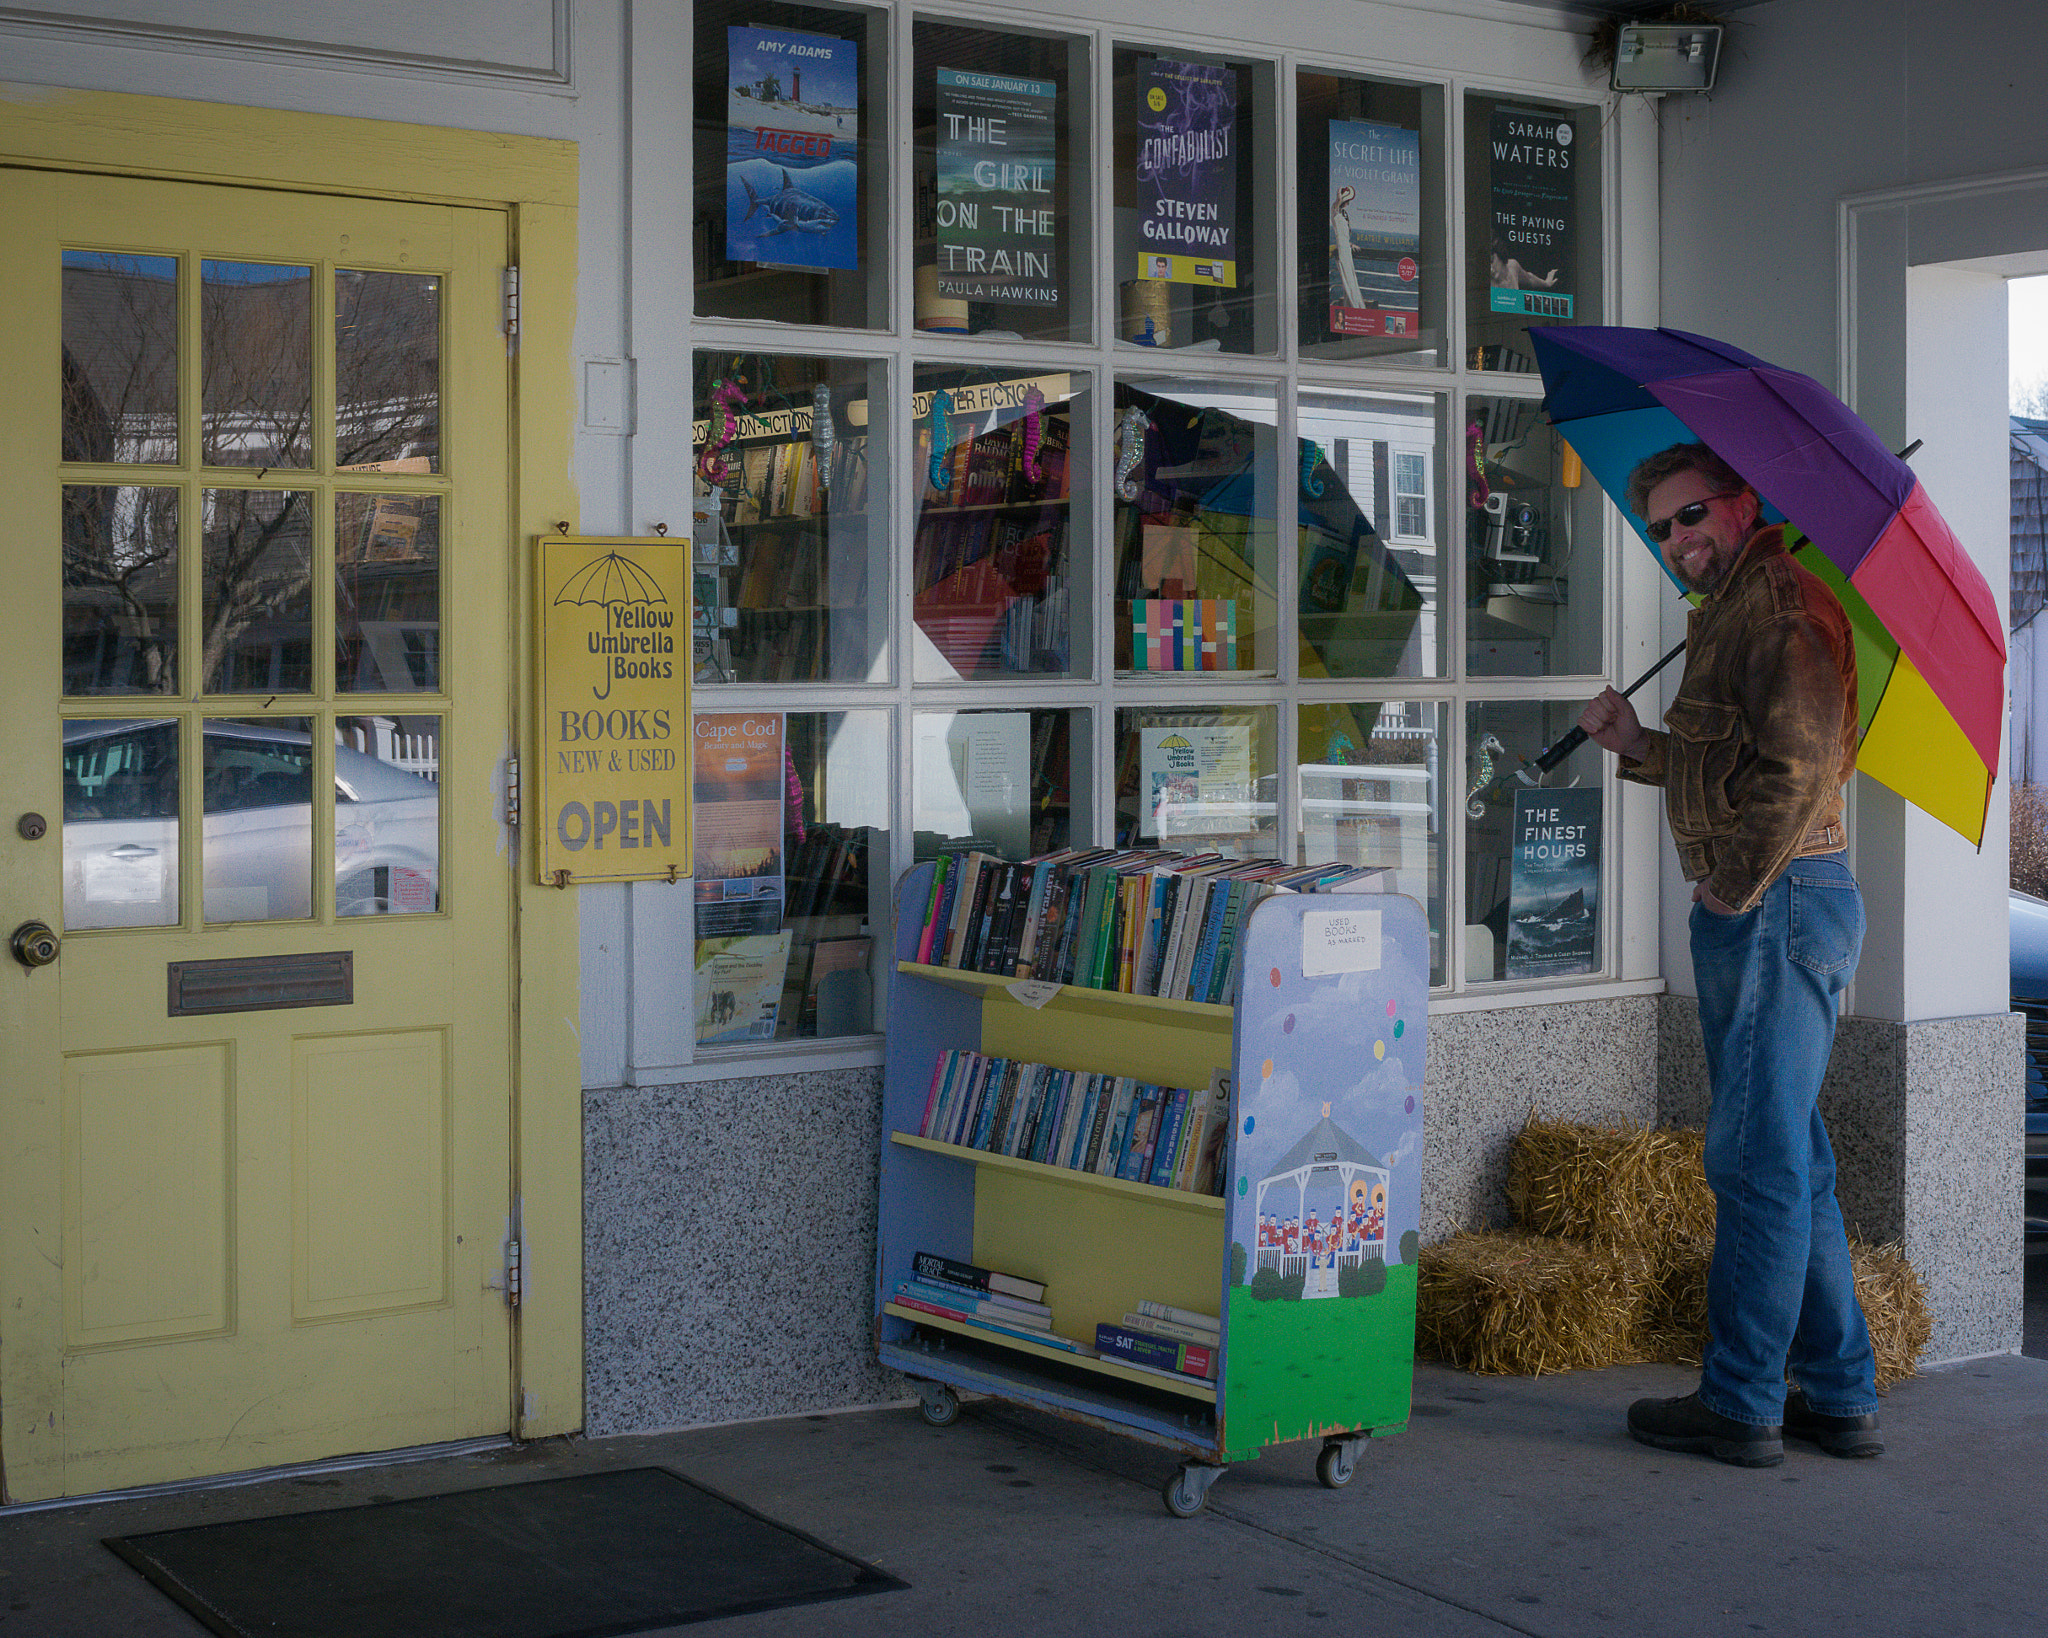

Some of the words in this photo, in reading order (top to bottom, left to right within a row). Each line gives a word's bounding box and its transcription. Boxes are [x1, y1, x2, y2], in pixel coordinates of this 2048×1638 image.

[757, 40, 786, 53] AMY
[788, 44, 833, 59] ADAMS
[955, 74, 969, 85] ON
[971, 76, 990, 88] SALE
[991, 79, 1029, 93] JANUARY
[1030, 83, 1041, 94] 13
[943, 113, 1007, 146] THE
[1161, 124, 1174, 133] THE
[1508, 122, 1554, 140] SARAH
[754, 126, 835, 157] TAGGED
[1144, 124, 1232, 170] CONFABULIST
[1334, 141, 1384, 162] SECRET
[1390, 148, 1414, 166] LIFE
[1492, 141, 1569, 168] WATERS
[974, 160, 1051, 193] GIRL
[937, 200, 979, 230] ON
[992, 205, 1055, 236] THE
[1156, 199, 1218, 220] STEVEN
[1496, 212, 1516, 226] THE
[1522, 216, 1564, 231] PAYING
[1143, 220, 1230, 246] GALLOWAY
[1508, 230, 1551, 246] GUESTS
[944, 244, 1048, 278] TRAIN
[938, 280, 984, 296] PAULA
[990, 284, 1058, 302] HAWKINS
[613, 606, 674, 628] Yellow
[588, 632, 674, 654] Umbrella
[614, 656, 672, 678] Books
[558, 709, 671, 742] BOOKS
[696, 720, 737, 742] Cape
[742, 719, 776, 736] Cod
[704, 742, 729, 752] Beauty
[730, 740, 745, 748] and
[746, 740, 768, 750] Magic
[558, 750, 602, 774] NEW
[608, 750, 622, 772] &
[628, 748, 676, 772] USED
[557, 798, 672, 852] OPEN
[1525, 808, 1560, 823] THE
[1524, 826, 1586, 841] FINEST
[1524, 844, 1586, 860] HOURS
[1040, 873, 1054, 916] LUPICA
[1219, 894, 1238, 945] HEIR
[1324, 924, 1357, 936] BOOKS
[1328, 918, 1350, 926] USED
[1166, 930, 1177, 960] FREEDOM
[1328, 938, 1336, 946] AS
[1338, 936, 1366, 944] MARKED
[1164, 1114, 1180, 1168] BASEBALL
[919, 1256, 945, 1270] MORTAL
[1116, 1336, 1134, 1350] SAT
